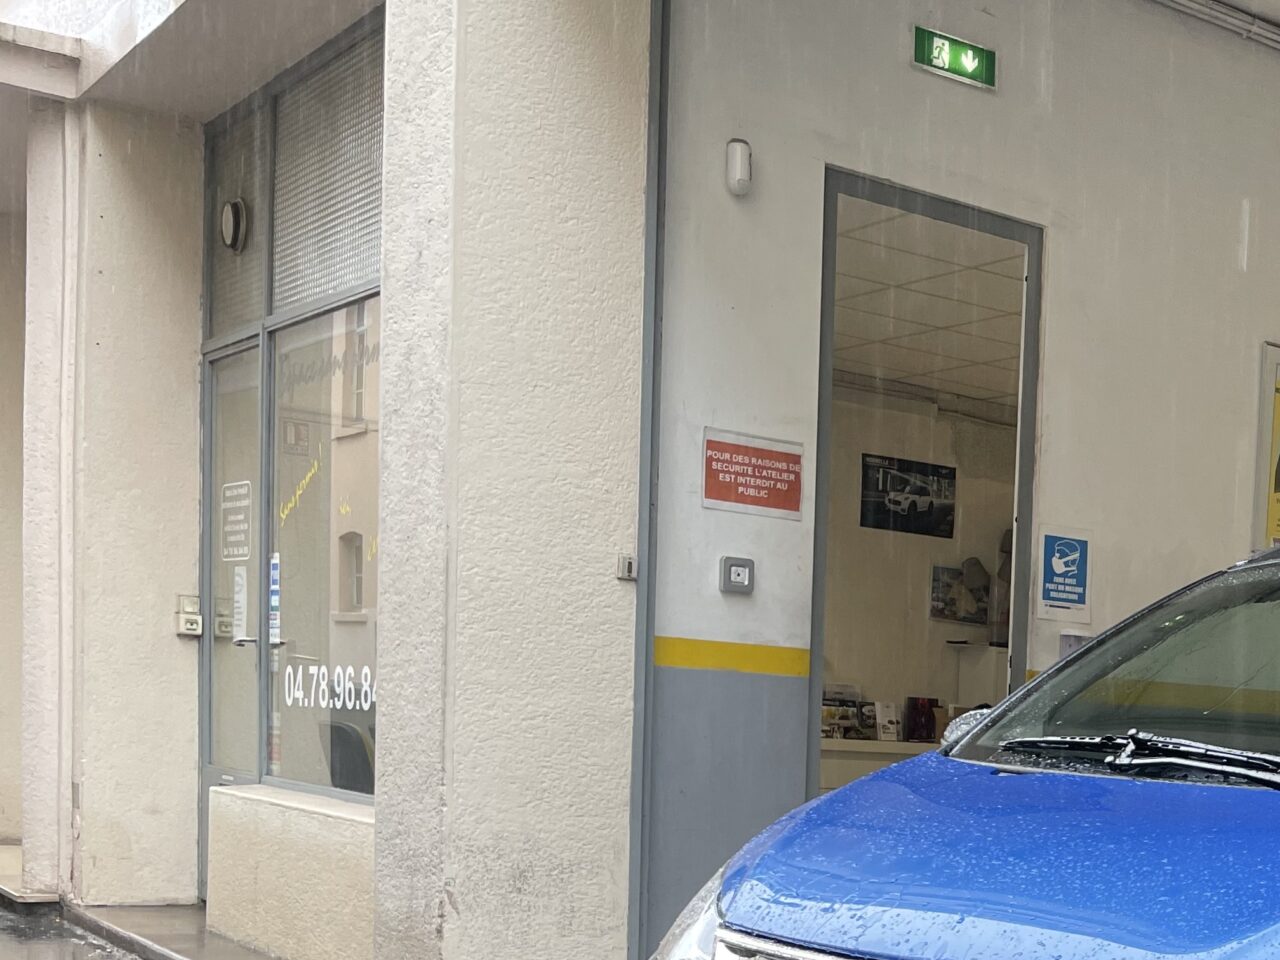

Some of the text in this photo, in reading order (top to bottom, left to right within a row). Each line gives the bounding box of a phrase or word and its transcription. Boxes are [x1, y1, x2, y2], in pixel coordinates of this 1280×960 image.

[706, 450, 801, 472] POUR DES RAISONS DE
[711, 461, 795, 481] SECURITE L'ATELIER
[719, 473, 788, 491] EST INTERDIT AU
[738, 486, 768, 498] PUBLIC
